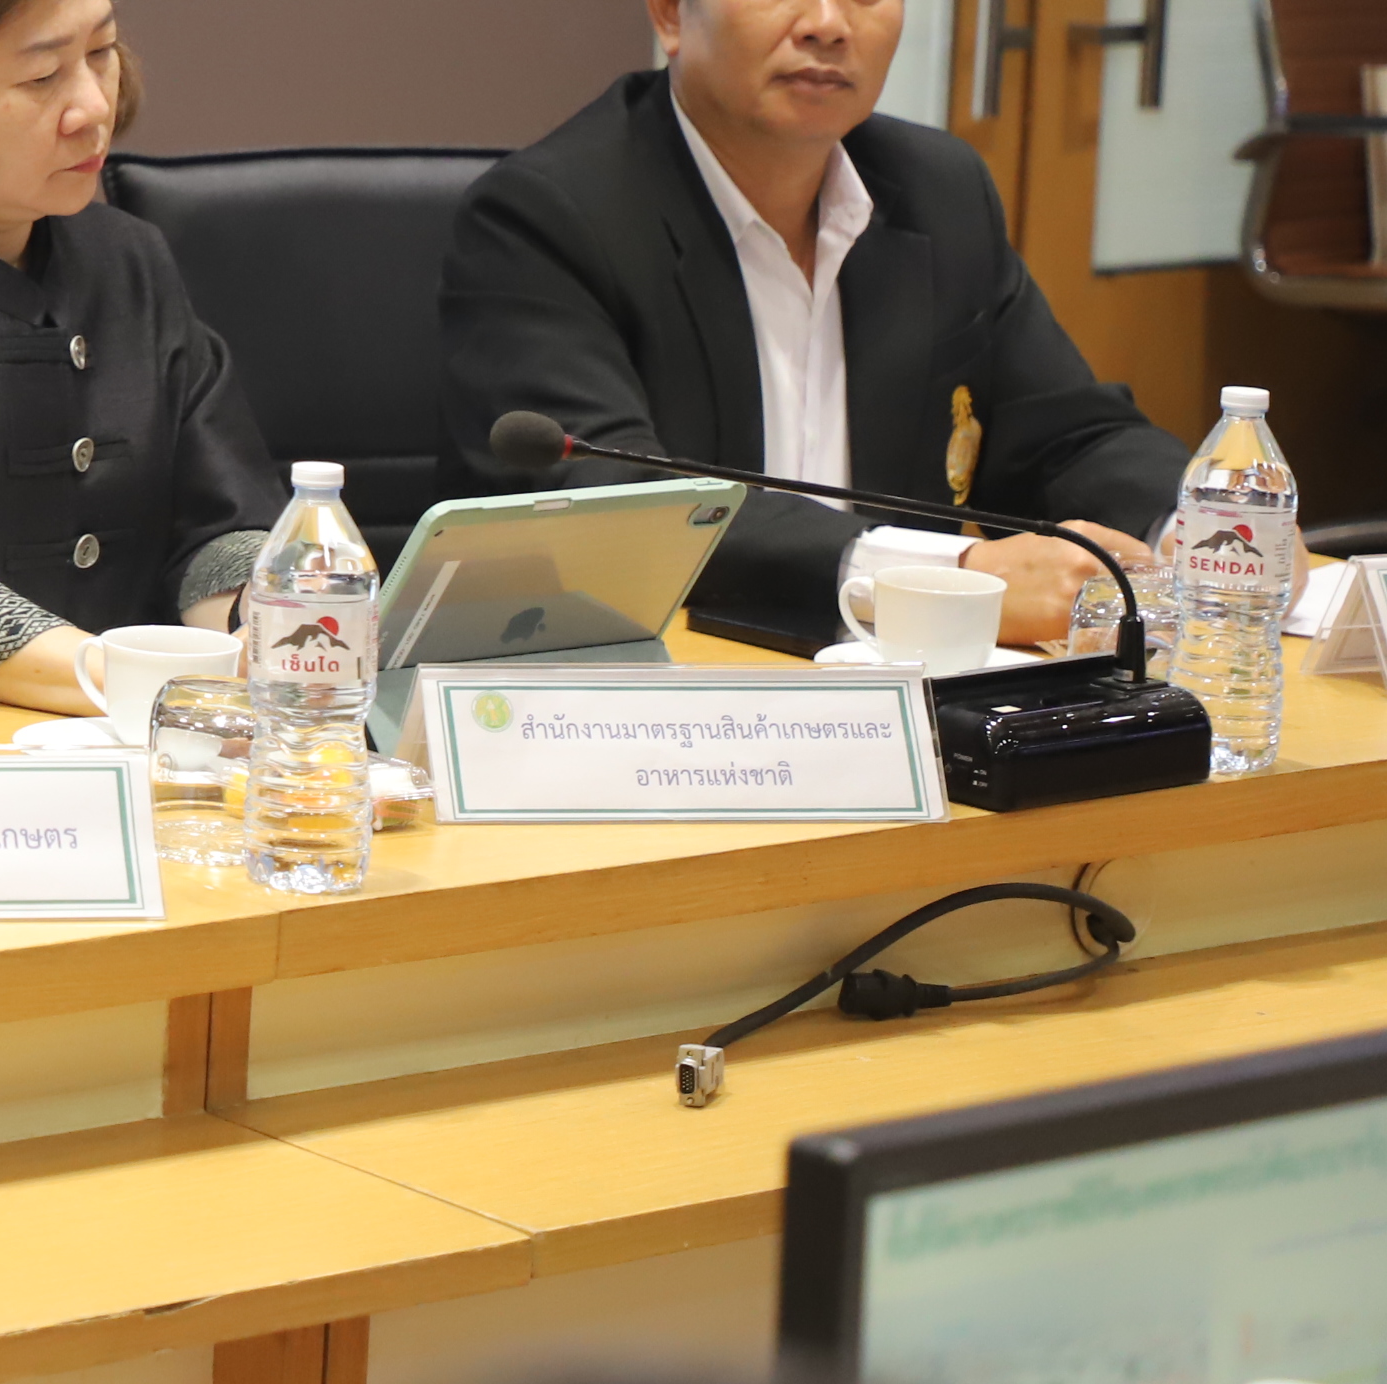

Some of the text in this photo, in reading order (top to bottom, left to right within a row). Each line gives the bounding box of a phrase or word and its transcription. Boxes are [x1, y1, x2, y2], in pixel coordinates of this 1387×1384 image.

[1189, 555, 1265, 576] SENDAI
[281, 653, 340, 673] เซ็นได
[520, 713, 894, 749] สำนักงานมาตรฐานสินค้าเกษตรและ
[634, 759, 795, 788] อาหารแห่งชาติ
